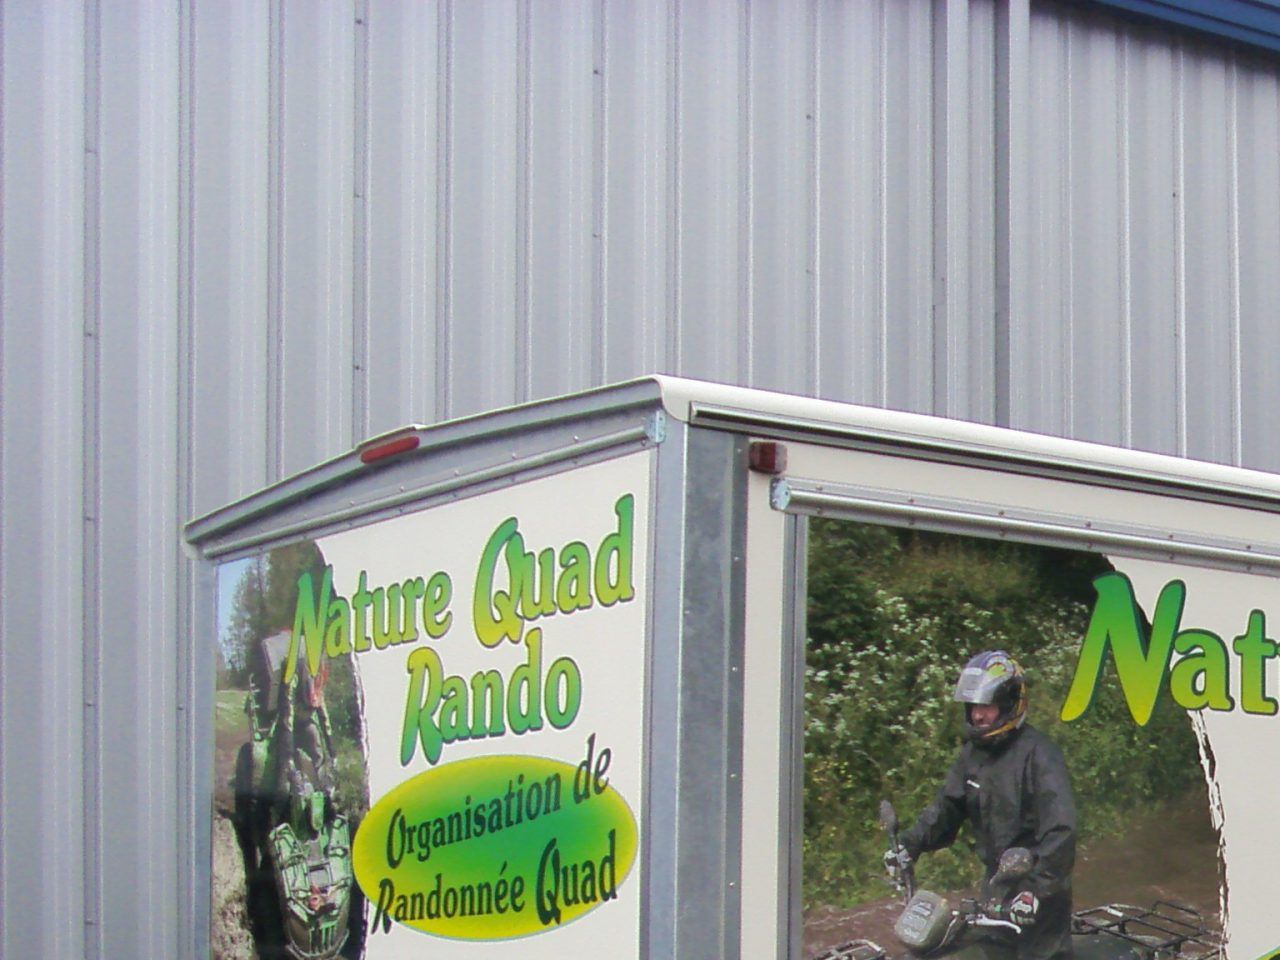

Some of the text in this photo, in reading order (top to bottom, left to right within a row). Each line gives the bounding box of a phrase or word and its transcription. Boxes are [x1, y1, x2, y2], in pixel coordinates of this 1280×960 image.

[283, 493, 635, 684] Nature Quad
[400, 627, 582, 766] Rando
[386, 734, 612, 869] Organisation de
[371, 829, 618, 935] Randonnée Quad
